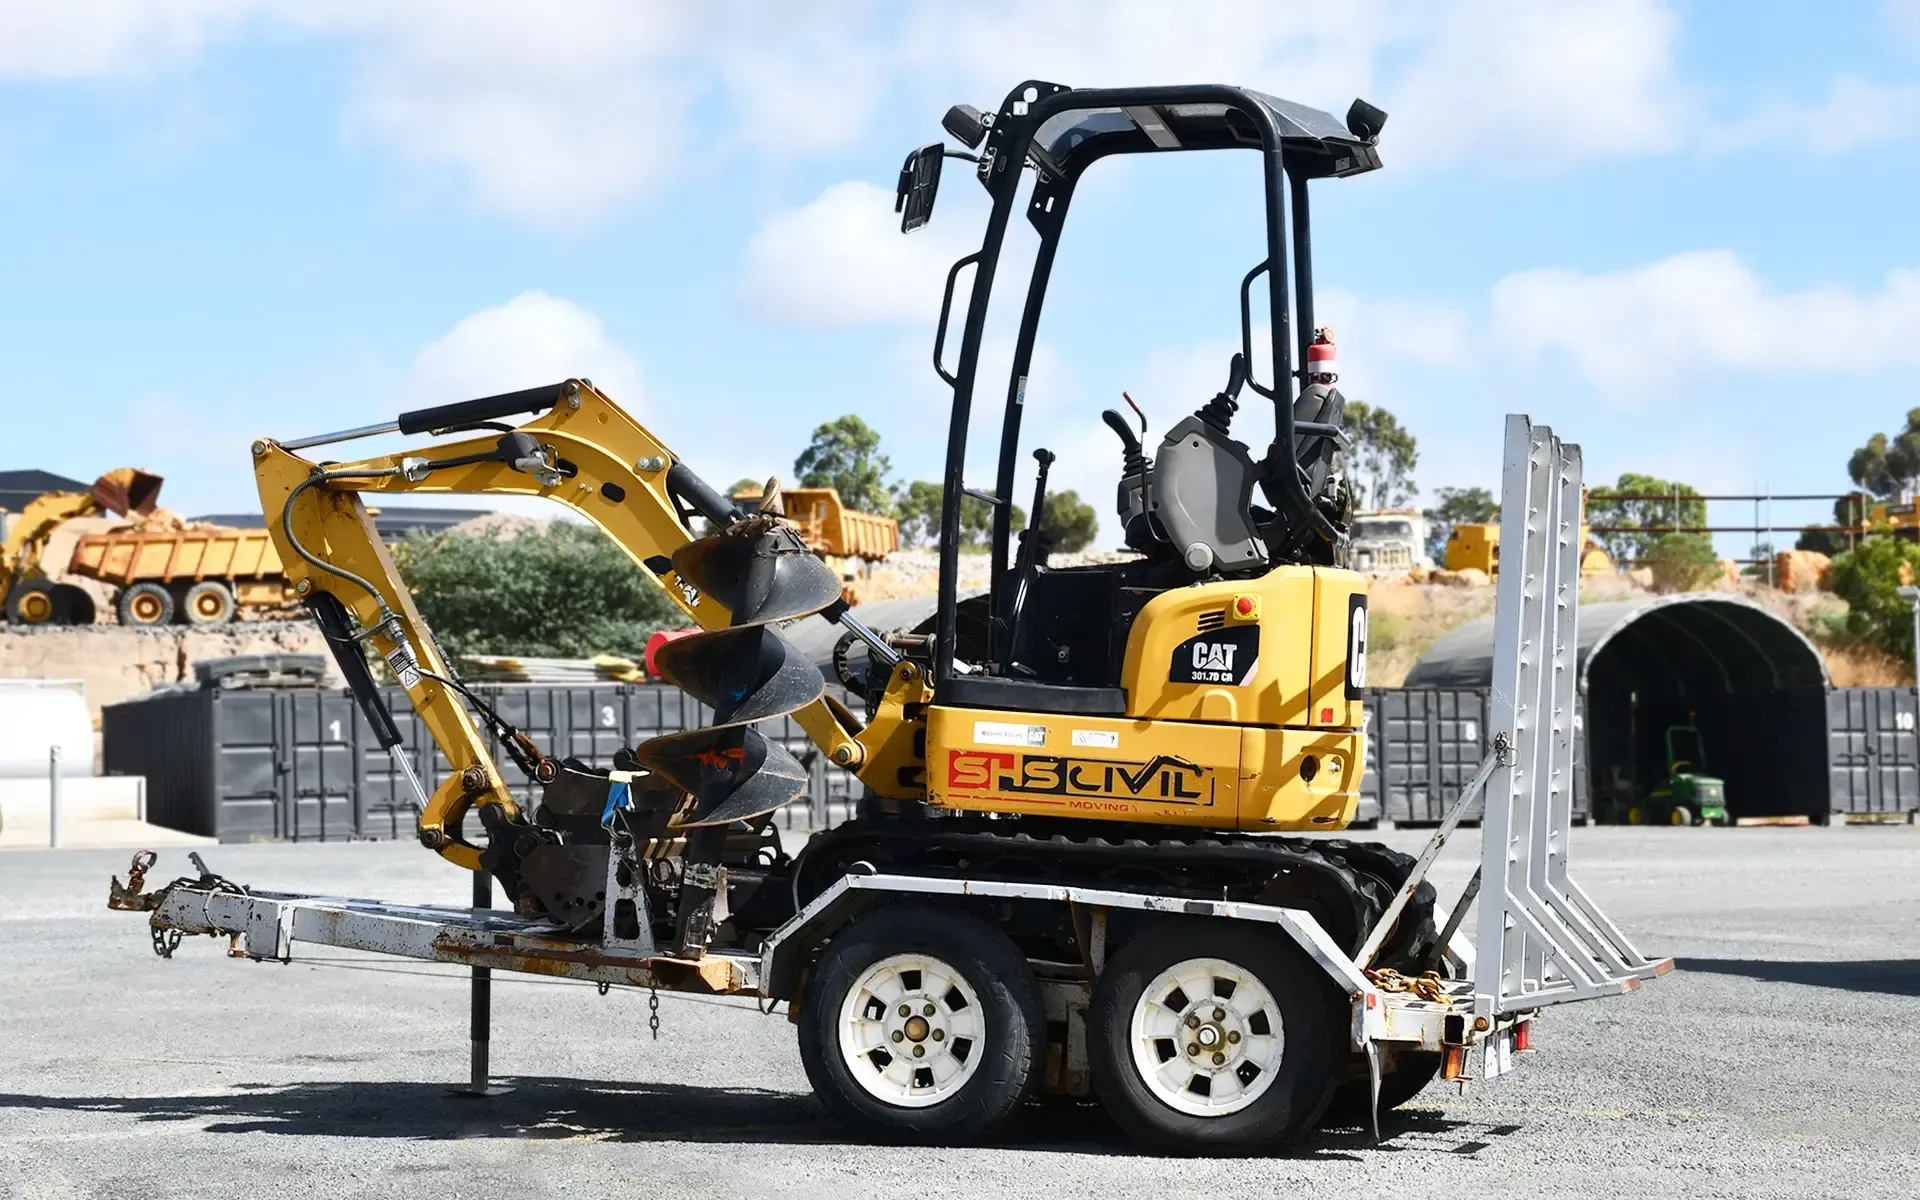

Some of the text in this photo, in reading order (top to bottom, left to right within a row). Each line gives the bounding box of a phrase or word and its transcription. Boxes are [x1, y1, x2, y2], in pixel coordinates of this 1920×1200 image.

[1192, 642, 1237, 671] CAT
[1191, 671, 1233, 682] 301.7D CR
[601, 705, 615, 727] 3
[1895, 711, 1914, 730] 10
[329, 719, 341, 741] 1
[1465, 721, 1476, 741] 8
[1069, 756, 1202, 797] CIVIL
[1069, 800, 1129, 812] MOVING
